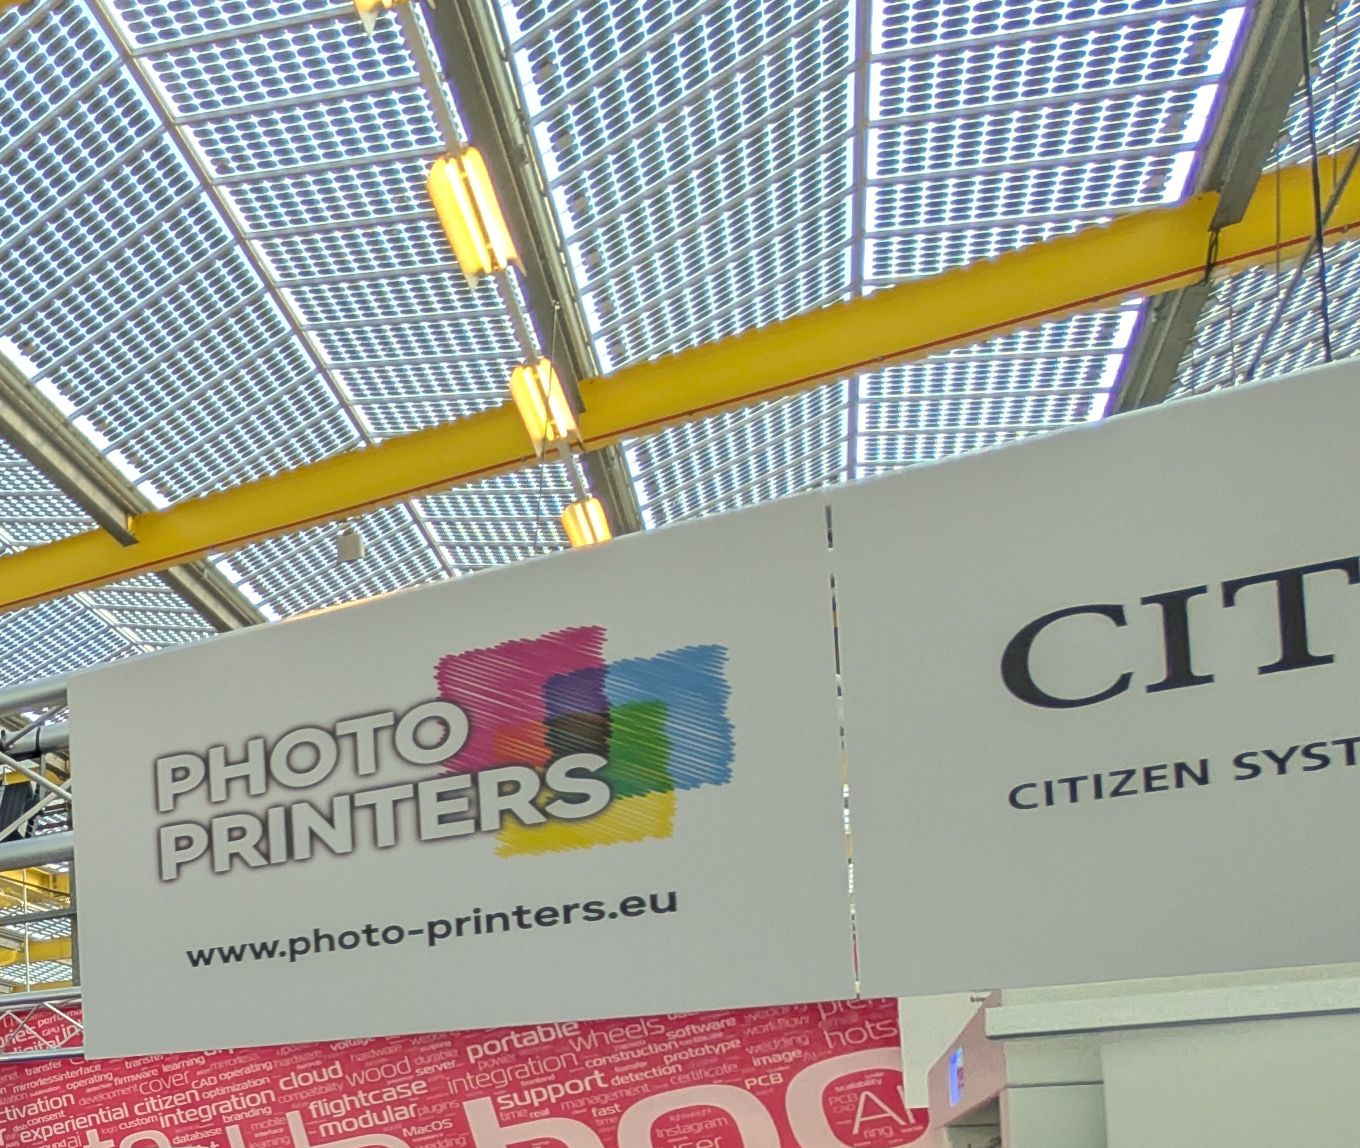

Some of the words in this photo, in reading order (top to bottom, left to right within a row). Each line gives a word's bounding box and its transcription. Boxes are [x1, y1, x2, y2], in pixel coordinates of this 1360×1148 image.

[153, 698, 471, 814] PHOTO
[1008, 759, 1209, 809] CITIZEN
[158, 751, 614, 882] PRINTERS
[186, 889, 679, 970] www.photo-printers.eu
[665, 1016, 737, 1039] software
[466, 1021, 580, 1063] portable
[663, 1037, 742, 1064] prototype
[25, 1060, 62, 1076] transfer
[219, 1060, 273, 1081] operating
[752, 1049, 803, 1067] image
[66, 1072, 113, 1091] operating
[113, 1068, 159, 1086] firmware
[138, 1070, 189, 1096] cover
[191, 1077, 218, 1089] CAD
[279, 1062, 343, 1091] cloud
[345, 1056, 412, 1087] wood
[447, 1050, 578, 1095] integration
[744, 1072, 784, 1090] PCB
[133, 1090, 200, 1116] citizen
[308, 1078, 428, 1119] flightcase
[497, 1069, 607, 1111] support
[27, 1110, 65, 1127] consent
[159, 1088, 276, 1128] integration
[222, 1105, 272, 1124] branding
[319, 1103, 417, 1139] modular
[590, 1104, 622, 1118] fast
[20, 1103, 129, 1143] experiential
[118, 1114, 158, 1130] custom
[172, 1125, 223, 1145] database
[402, 1118, 453, 1138] MacOS
[863, 1126, 893, 1139] ring
